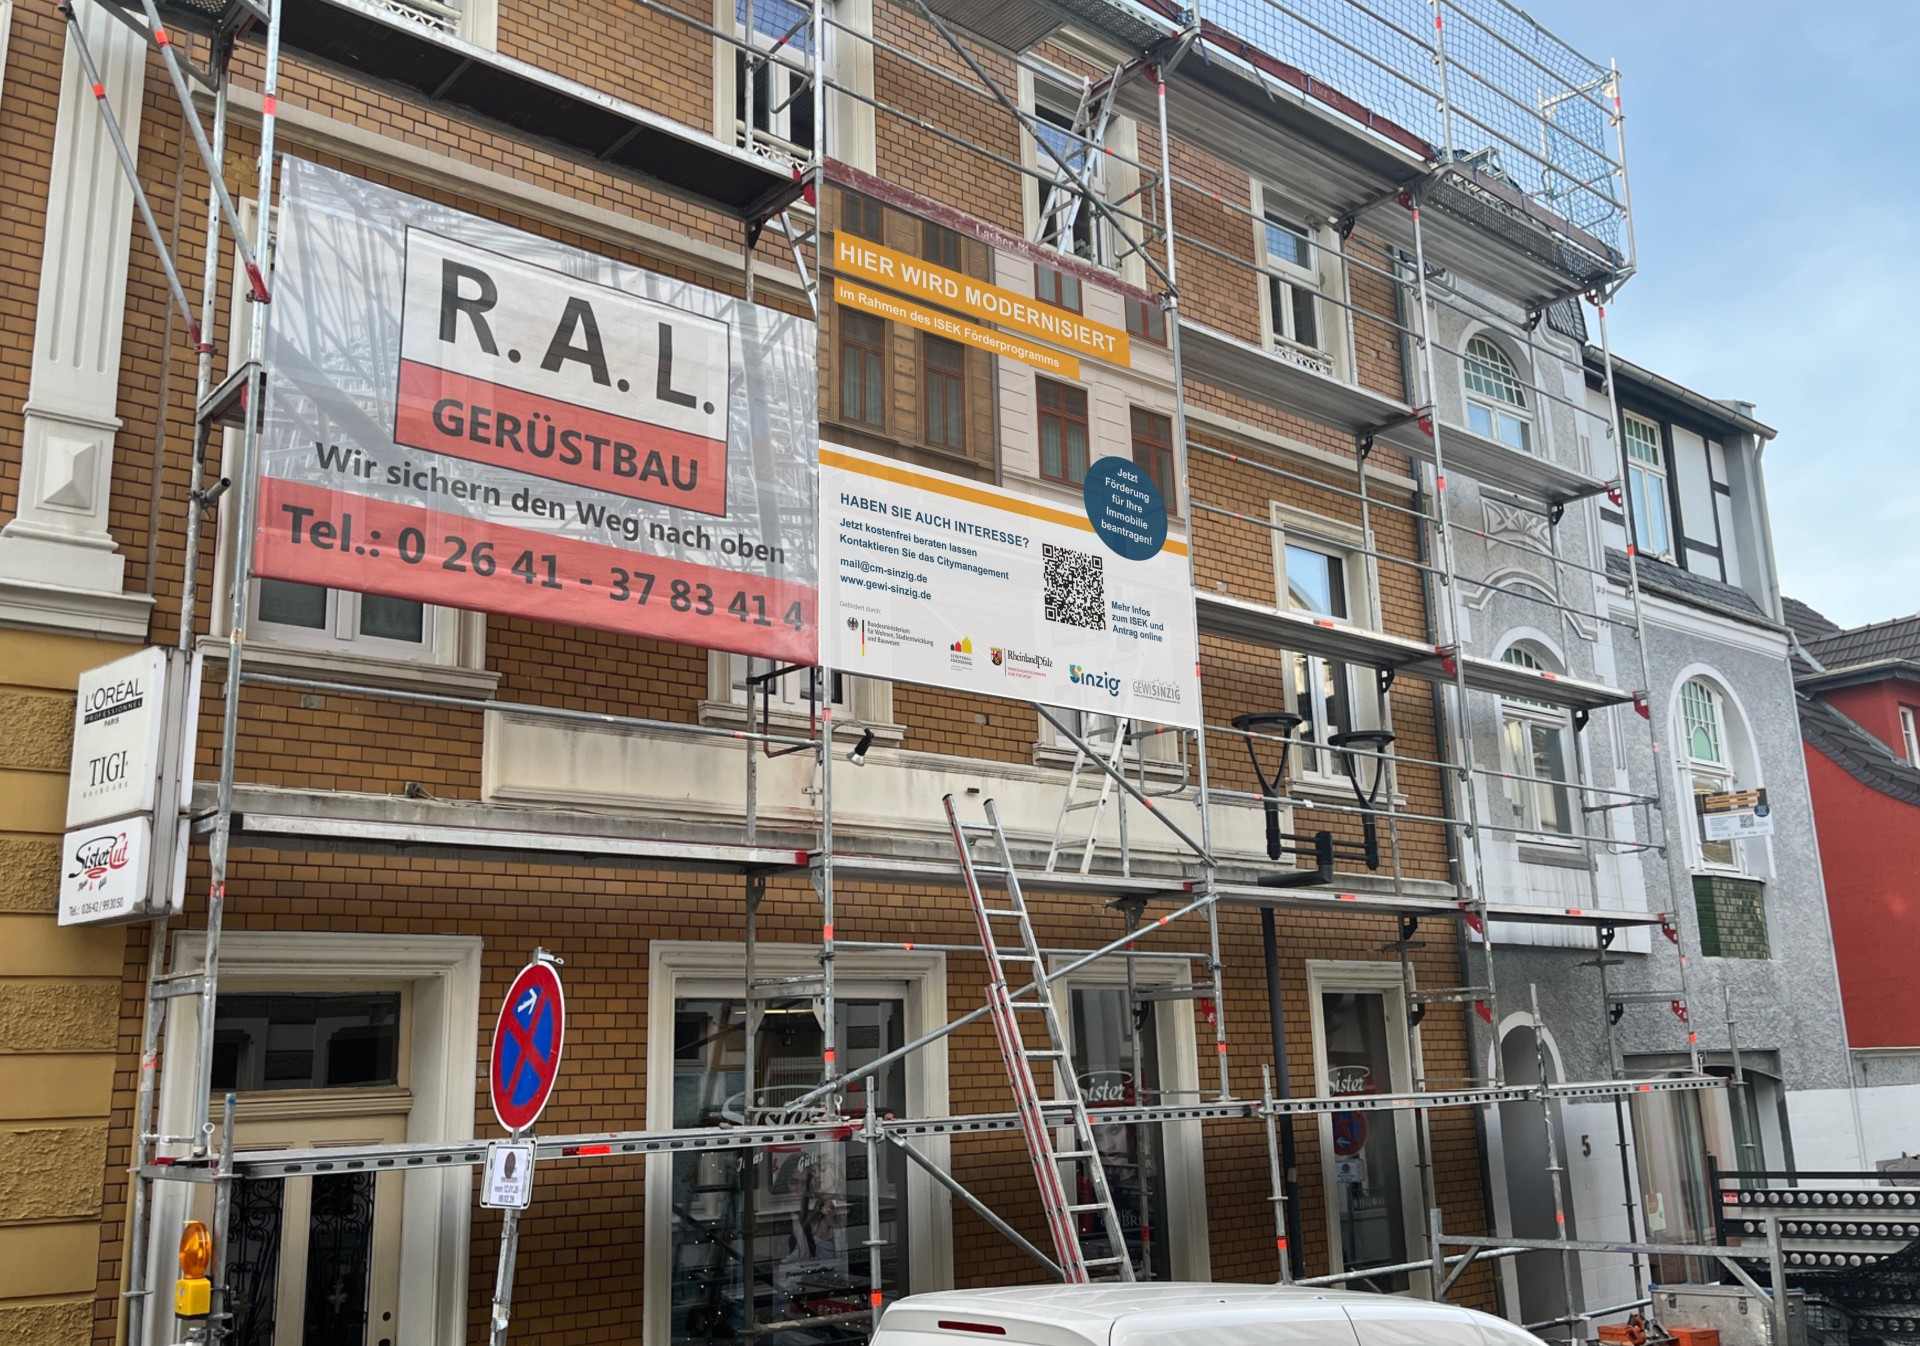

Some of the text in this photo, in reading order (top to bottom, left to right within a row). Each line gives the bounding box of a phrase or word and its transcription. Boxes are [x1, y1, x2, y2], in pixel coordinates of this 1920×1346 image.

[839, 241, 1117, 354] HIER WIRD MODERNISIERT
[438, 257, 716, 416] R.A.L.
[839, 286, 1060, 369] Im Rahmen des ISEK Förderprogramms
[432, 397, 699, 492] GERÜSTBAU
[1105, 476, 1150, 503] Förderung
[1117, 468, 1138, 484] Jetzt
[315, 441, 786, 564] Wir sichern den Weg nach oben
[1111, 494, 1143, 513] für Ihre
[840, 492, 1030, 548] HABEN SIE AUCH INTERESSE?
[1106, 506, 1148, 529] Immobilie
[840, 518, 978, 557] Jetzt kostenfrei beraten lassen
[1101, 519, 1152, 546] beantragen!
[282, 503, 805, 632] Tel.: 0 26 41 - 37 83 41 4
[840, 533, 1010, 580] Kontaktieren Sie das Citymanagement
[840, 557, 928, 584] mail@cm-sinzig.de
[840, 575, 932, 601] www.gewi-sinzig.de
[839, 600, 865, 611] Gefördert
[1111, 600, 1151, 617] Mehr Infos
[1111, 614, 1164, 632] zum ISEK und
[1112, 624, 1163, 643] Antrag online
[1069, 663, 1121, 697] Sinzig
[84, 678, 144, 713] L'ORÉAL
[84, 697, 143, 724] PROFESSIONNEL
[104, 717, 120, 727] PARIS
[1581, 1134, 1592, 1158] 5
